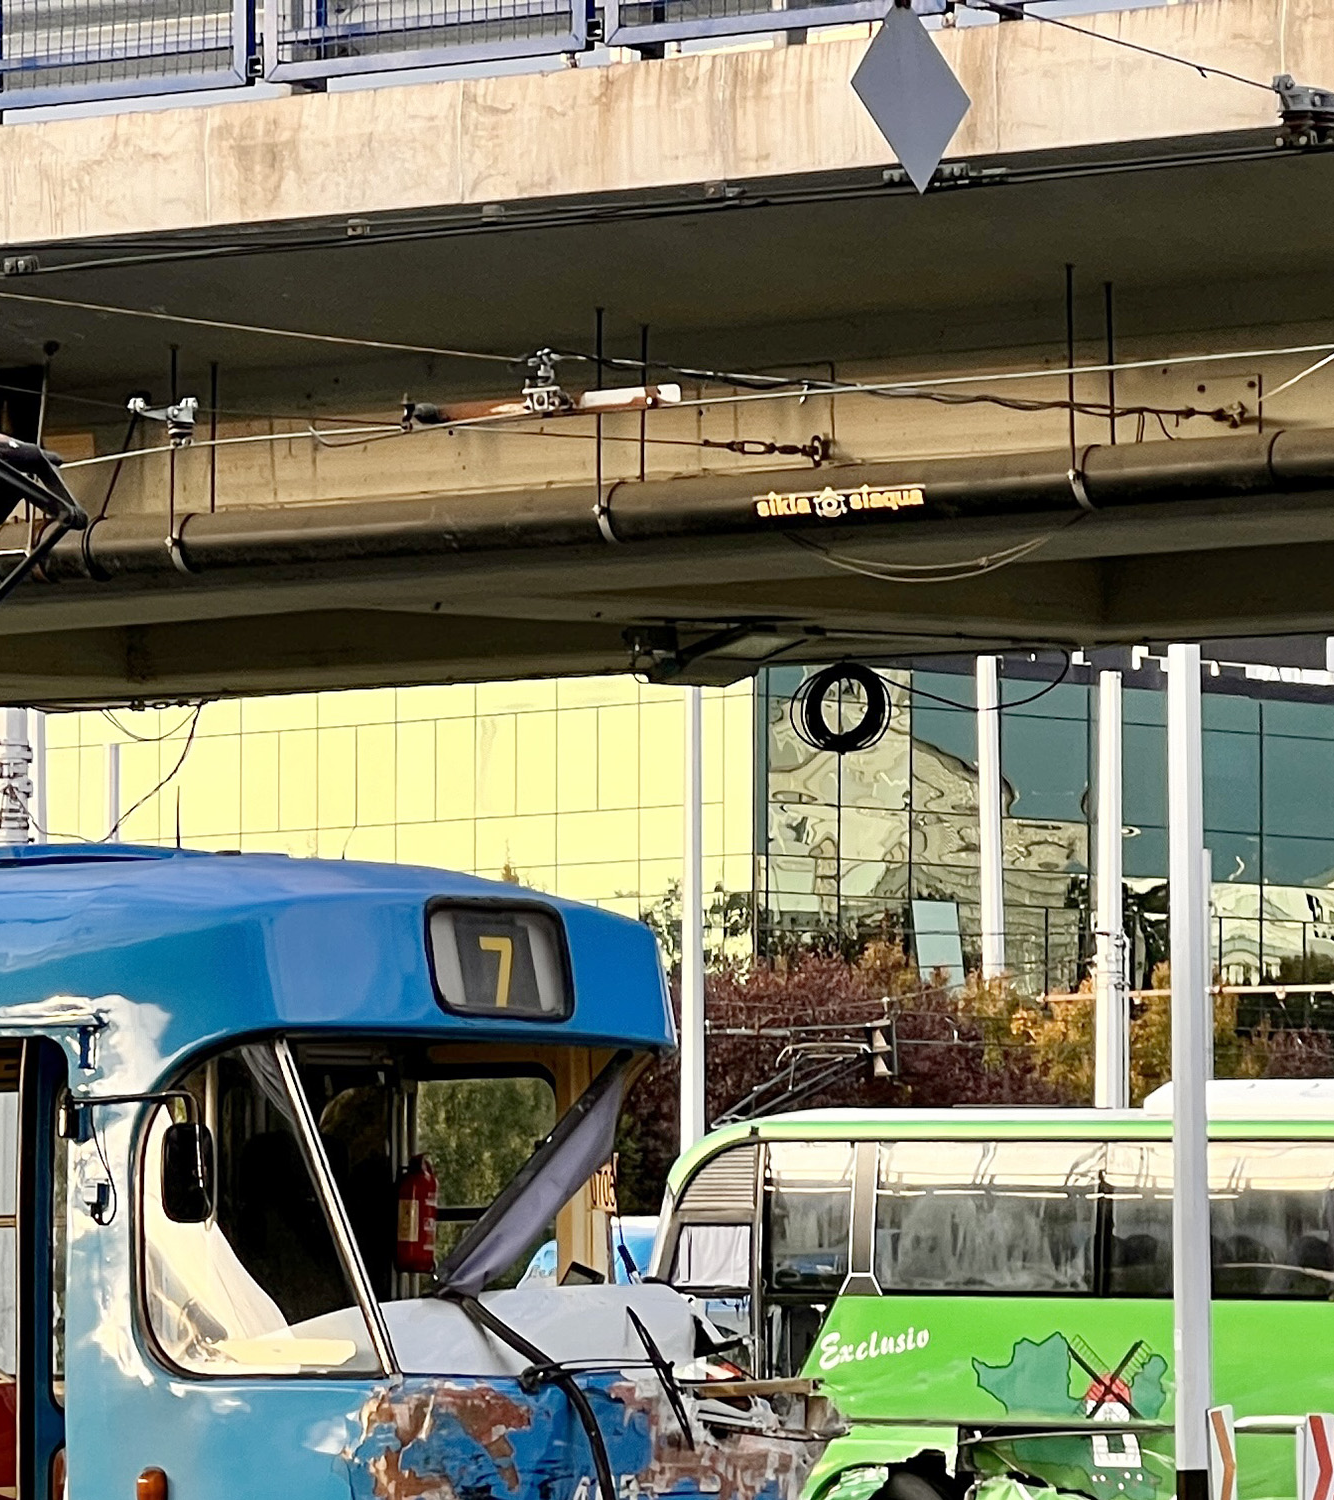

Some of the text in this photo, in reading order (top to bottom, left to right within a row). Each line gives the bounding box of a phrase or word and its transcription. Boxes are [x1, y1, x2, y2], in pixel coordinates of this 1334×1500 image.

[756, 491, 811, 517] sikla
[479, 936, 512, 1007] 7
[819, 1326, 930, 1370] Exclusio
